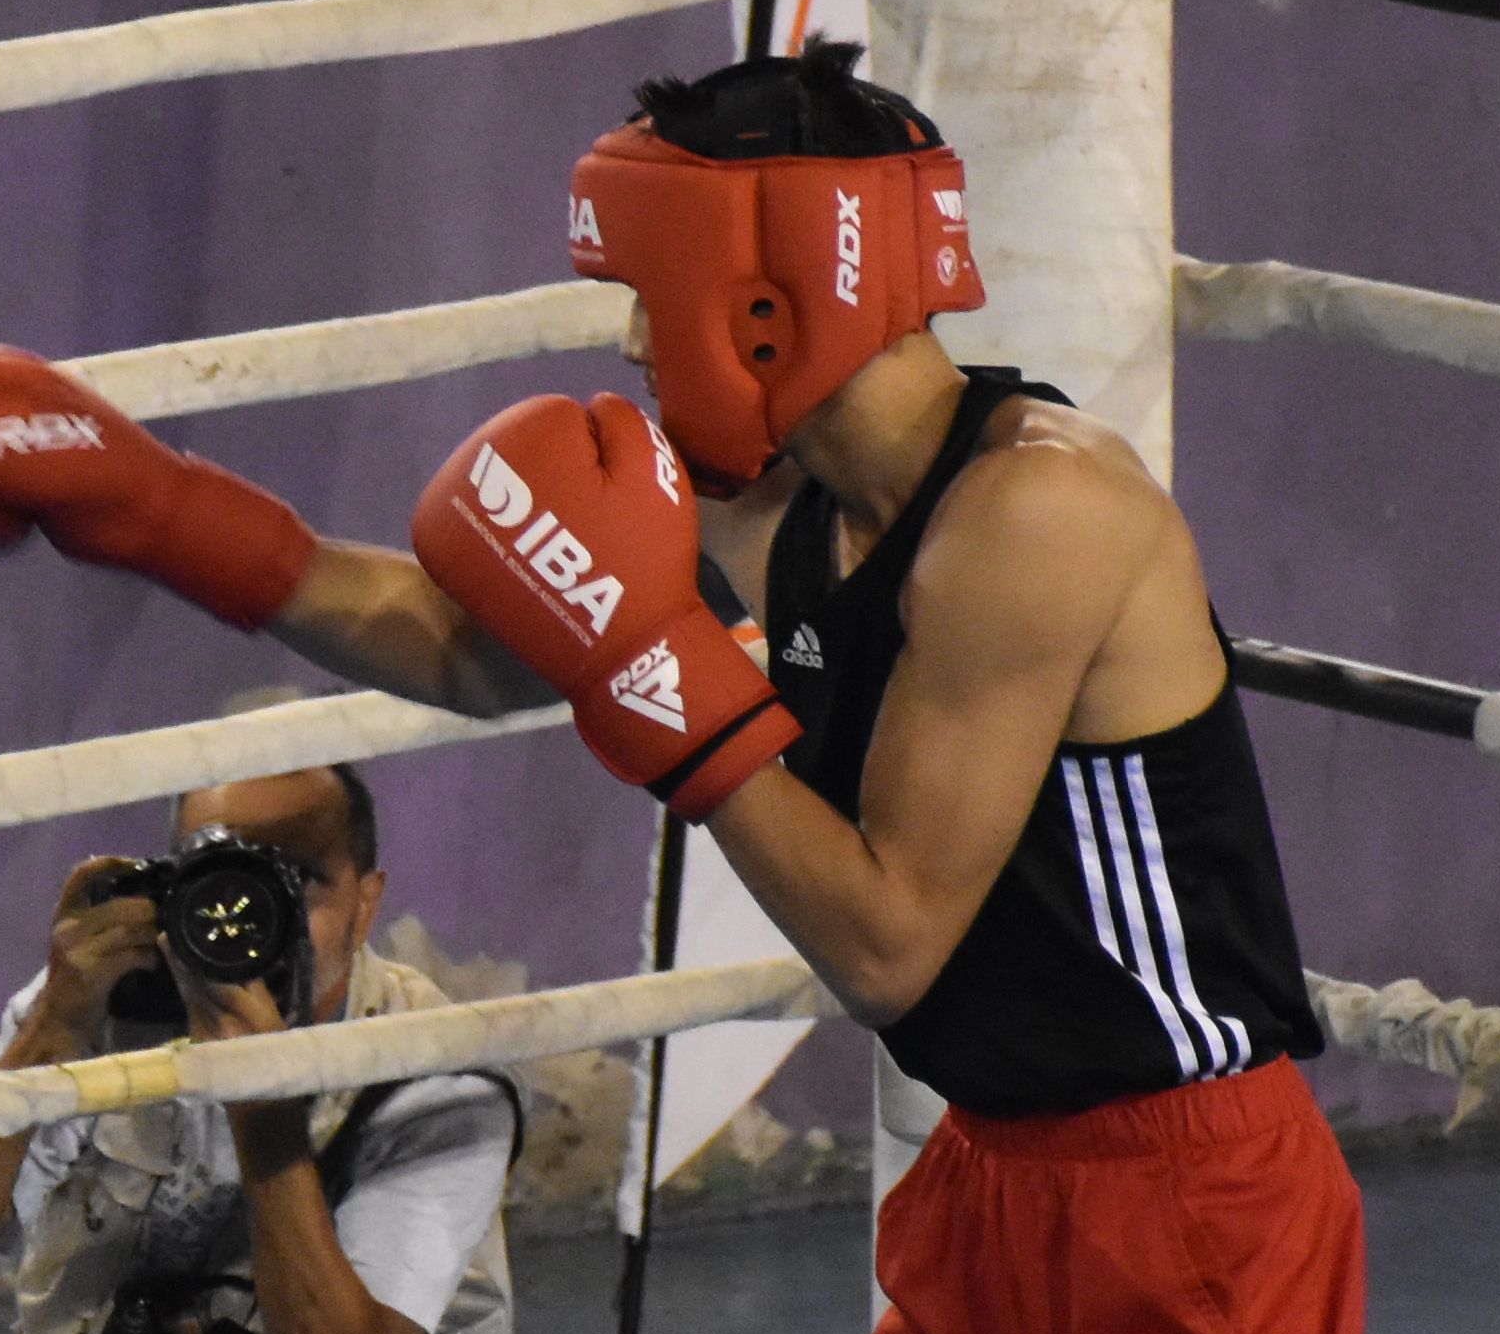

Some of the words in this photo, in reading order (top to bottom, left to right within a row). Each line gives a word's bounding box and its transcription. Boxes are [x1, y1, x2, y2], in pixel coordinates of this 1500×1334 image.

[836, 186, 862, 308] RDX
[640, 409, 679, 505] RD
[513, 510, 625, 636] IBA
[609, 637, 673, 702] RDX
